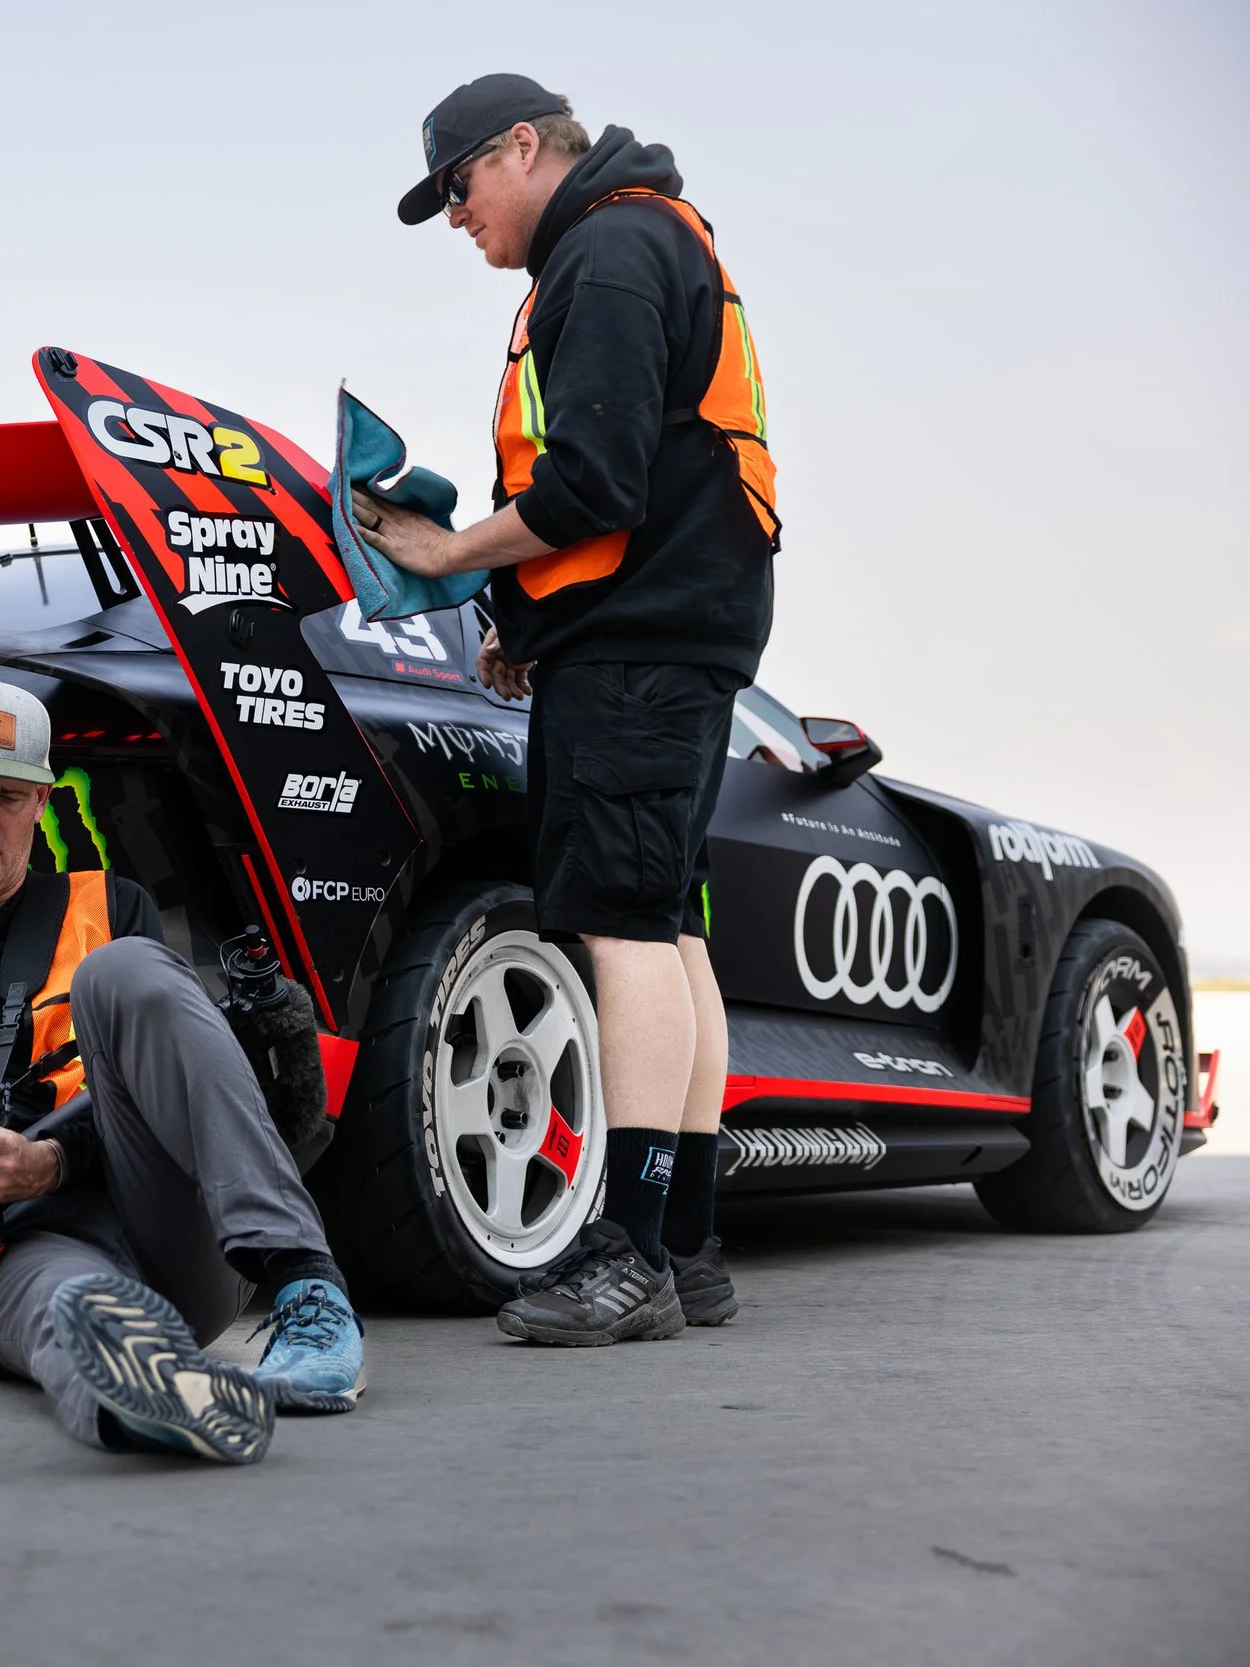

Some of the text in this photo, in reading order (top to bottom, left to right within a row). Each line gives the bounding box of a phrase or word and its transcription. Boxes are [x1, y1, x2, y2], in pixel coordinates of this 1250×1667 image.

[88, 400, 267, 485] CSR2
[168, 510, 275, 555] Spray
[188, 555, 273, 595] Nine
[339, 597, 448, 662] 43
[220, 662, 303, 697] TOYO
[408, 665, 462, 682] Audi Sport
[236, 695, 326, 731] TIRES
[280, 799, 329, 810] EXHAUST
[281, 770, 359, 812] Borla
[312, 880, 386, 902] FCP EURO
[423, 914, 486, 1198] TOYO TIRES
